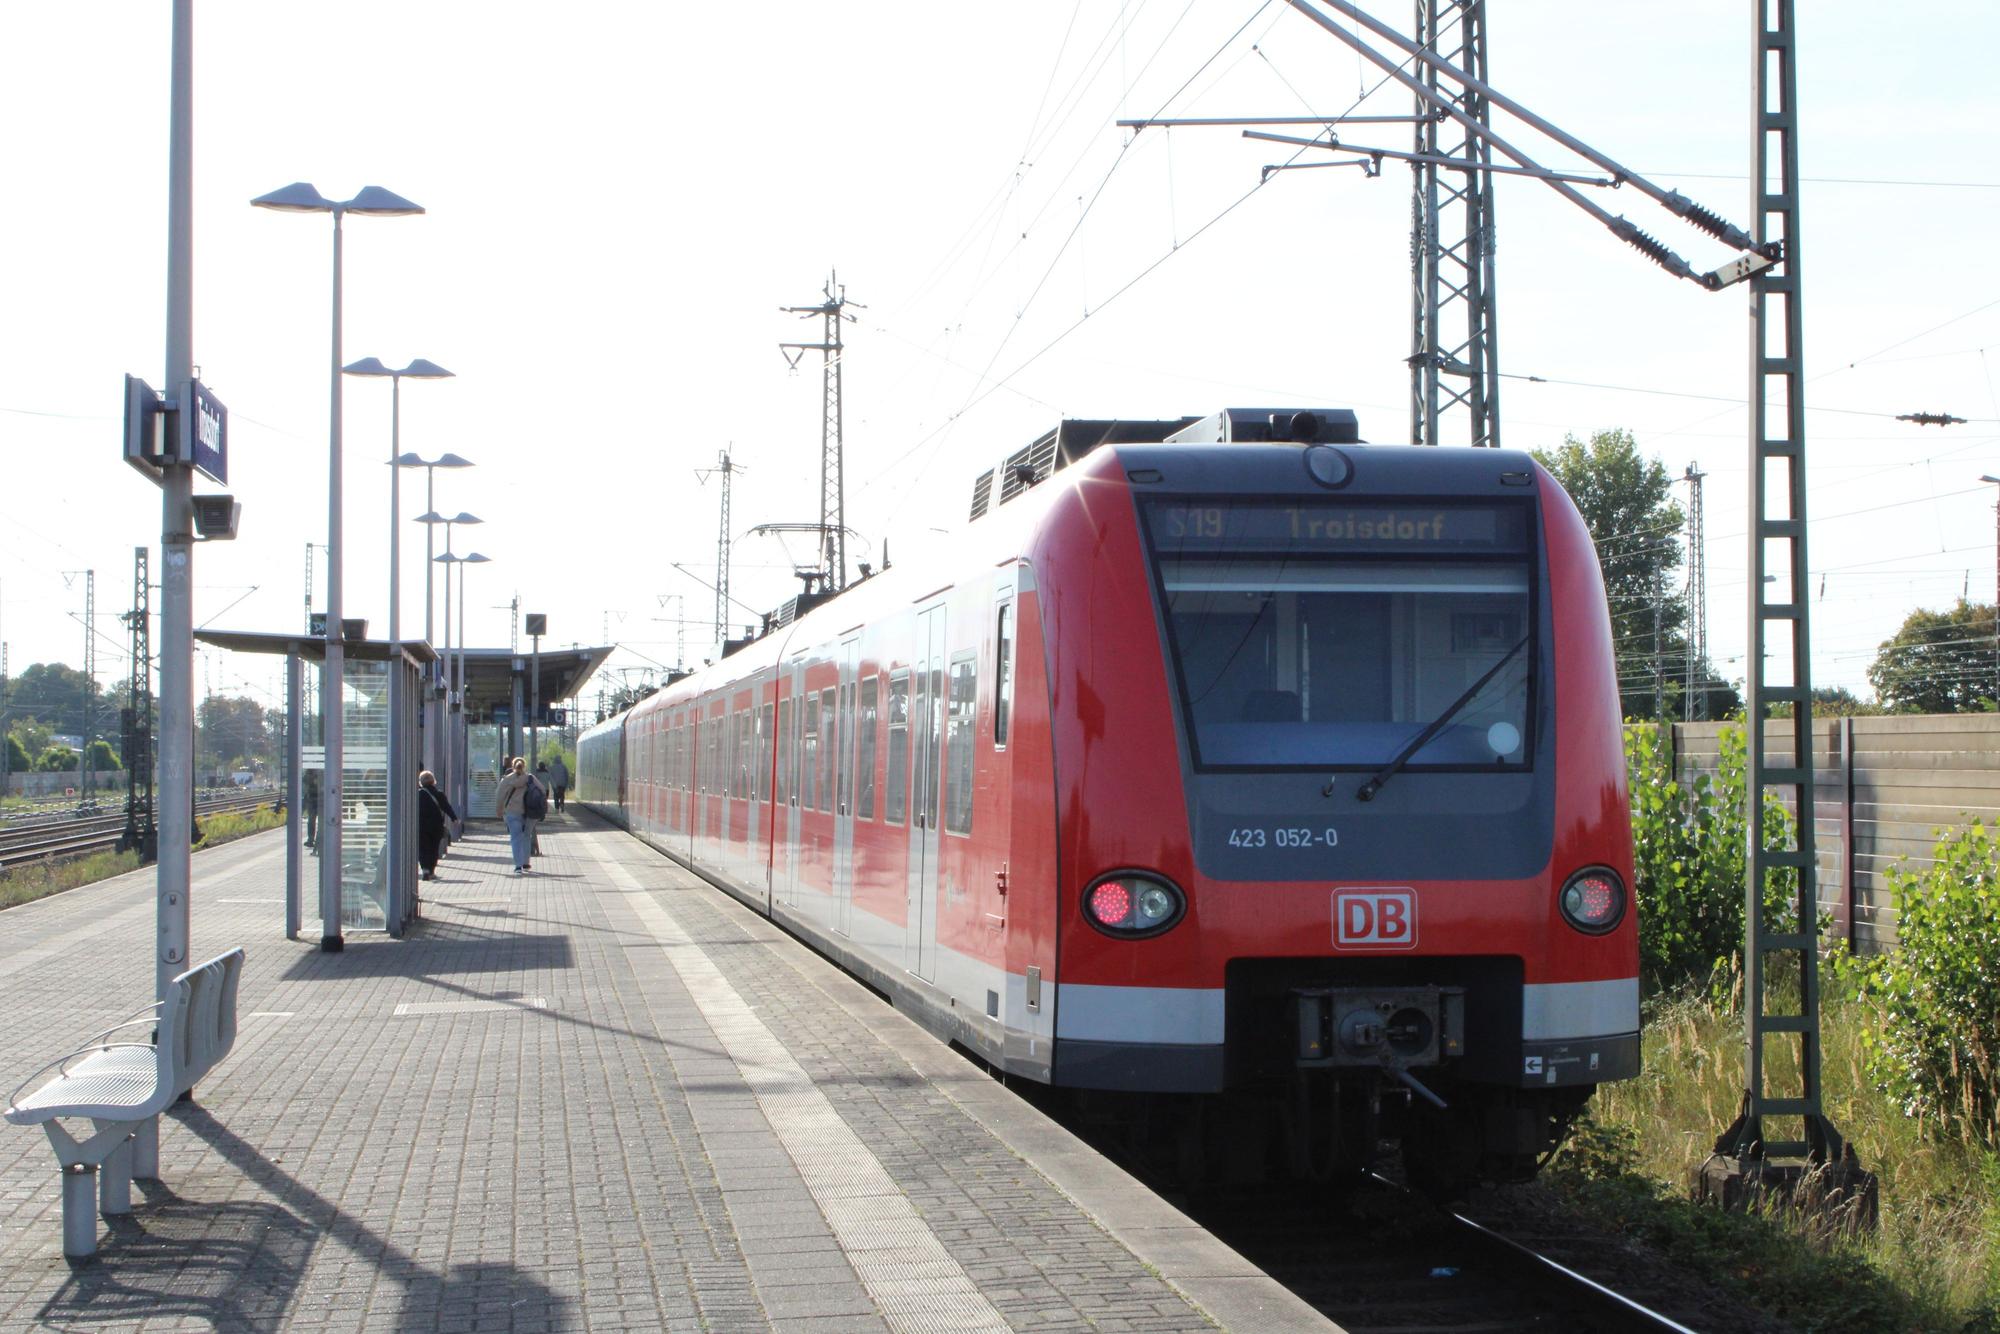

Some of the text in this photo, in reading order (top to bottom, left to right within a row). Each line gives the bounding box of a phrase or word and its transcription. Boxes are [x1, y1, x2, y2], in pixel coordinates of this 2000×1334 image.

[1169, 508, 1445, 540] S19 Troisdorf
[554, 709, 564, 723] 6
[1228, 828, 1338, 847] 423 052-0
[1343, 898, 1407, 940] DB
